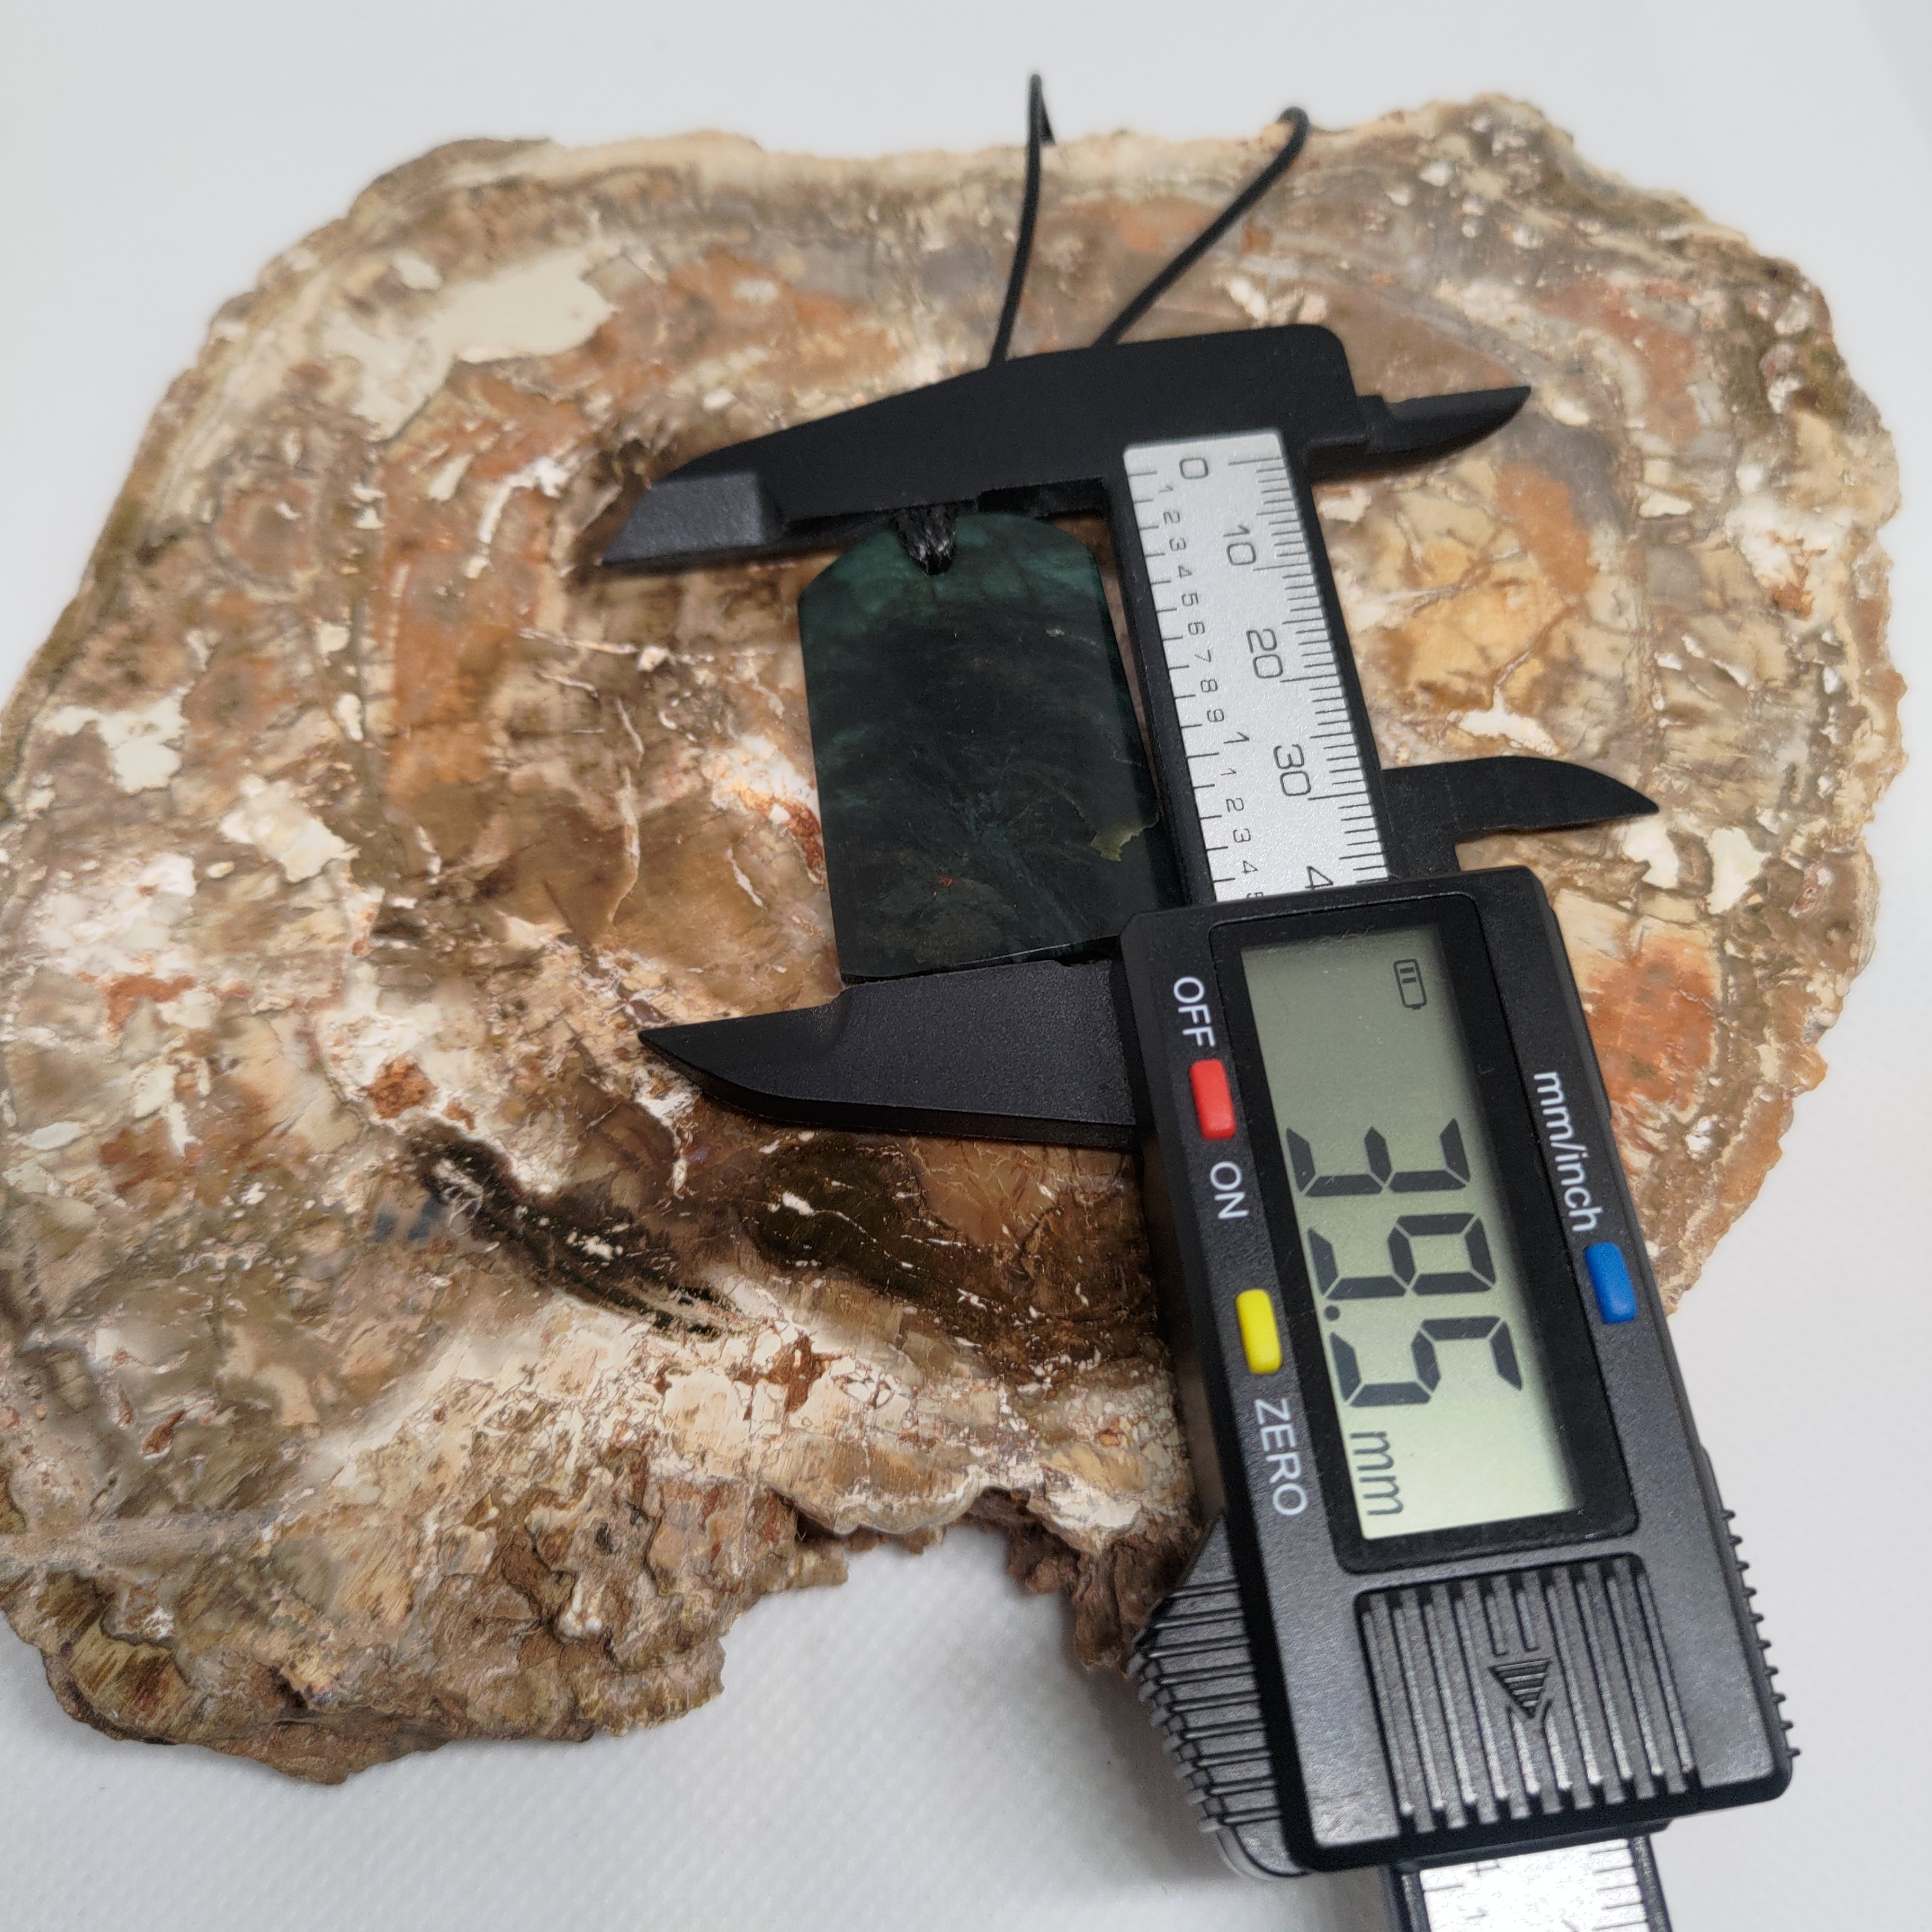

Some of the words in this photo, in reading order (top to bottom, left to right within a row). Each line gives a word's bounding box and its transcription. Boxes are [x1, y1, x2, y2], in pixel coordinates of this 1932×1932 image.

[1157, 484, 1174, 494] 1
[1162, 510, 1180, 525] 2
[1169, 537, 1187, 551] 3
[1177, 565, 1193, 579] 4
[1180, 592, 1199, 607] 5
[1179, 457, 1209, 480] 0
[1223, 524, 1257, 566] 10
[1246, 628, 1284, 679] 20
[1273, 744, 1312, 797] 30
[1187, 621, 1205, 636] 6
[1194, 649, 1212, 663] 7
[1200, 678, 1218, 693] 8
[1206, 708, 1224, 723] 9
[1223, 732, 1250, 744] 1
[1220, 767, 1237, 776] 1
[1225, 797, 1245, 813] 2
[1232, 828, 1251, 843] 3
[1242, 860, 1259, 874] 4
[1173, 976, 1216, 1047] OFF
[1533, 1071, 1602, 1233] mm/inch
[1209, 1161, 1249, 1220] ON
[1286, 1117, 1523, 1407] 39.5
[1254, 1397, 1308, 1516] ZERO
[1349, 1430, 1403, 1517] mm
